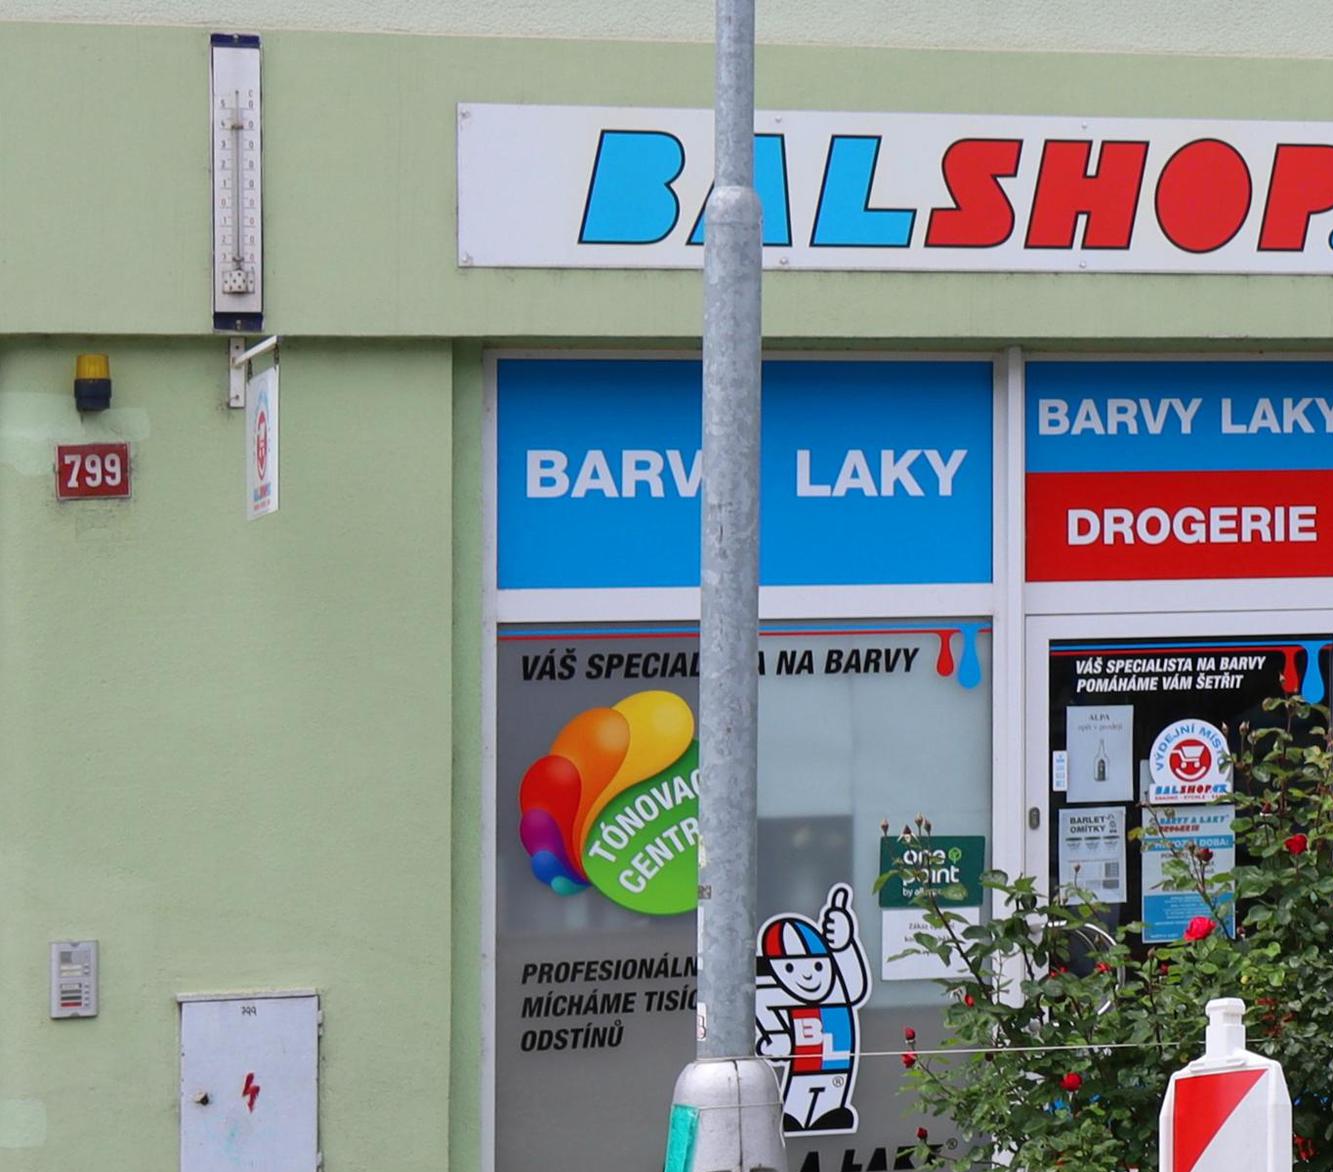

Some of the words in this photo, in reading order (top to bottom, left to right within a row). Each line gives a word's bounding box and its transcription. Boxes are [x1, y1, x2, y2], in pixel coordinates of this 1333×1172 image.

[1038, 398, 1202, 436] BARVY
[64, 454, 122, 488] 799
[526, 449, 704, 498] BARV
[796, 449, 967, 498] LAKY
[1066, 506, 1318, 546] DROGERIE
[521, 648, 577, 681] VÁŠ
[585, 650, 766, 679] SPECIAL
[776, 650, 817, 677] NA
[824, 647, 919, 675] BARVY
[1076, 657, 1103, 674] VÁŠ
[1106, 658, 1193, 673] SPECIALISTA
[1196, 657, 1216, 671] NA
[1219, 656, 1266, 670] BARVY
[1076, 675, 1158, 692] POMÁHÁME
[1162, 674, 1192, 690] VÁM
[1196, 673, 1244, 689] ŠETŘIT
[1155, 724, 1195, 771] VÝDEJNÍ
[619, 817, 700, 893] CENTR
[521, 953, 698, 985] PROFESIONÁLN
[521, 989, 637, 1018] MÍCHÁME
[645, 985, 698, 1012] TISÍC
[521, 1019, 624, 1052] ODSTÍNŮ
